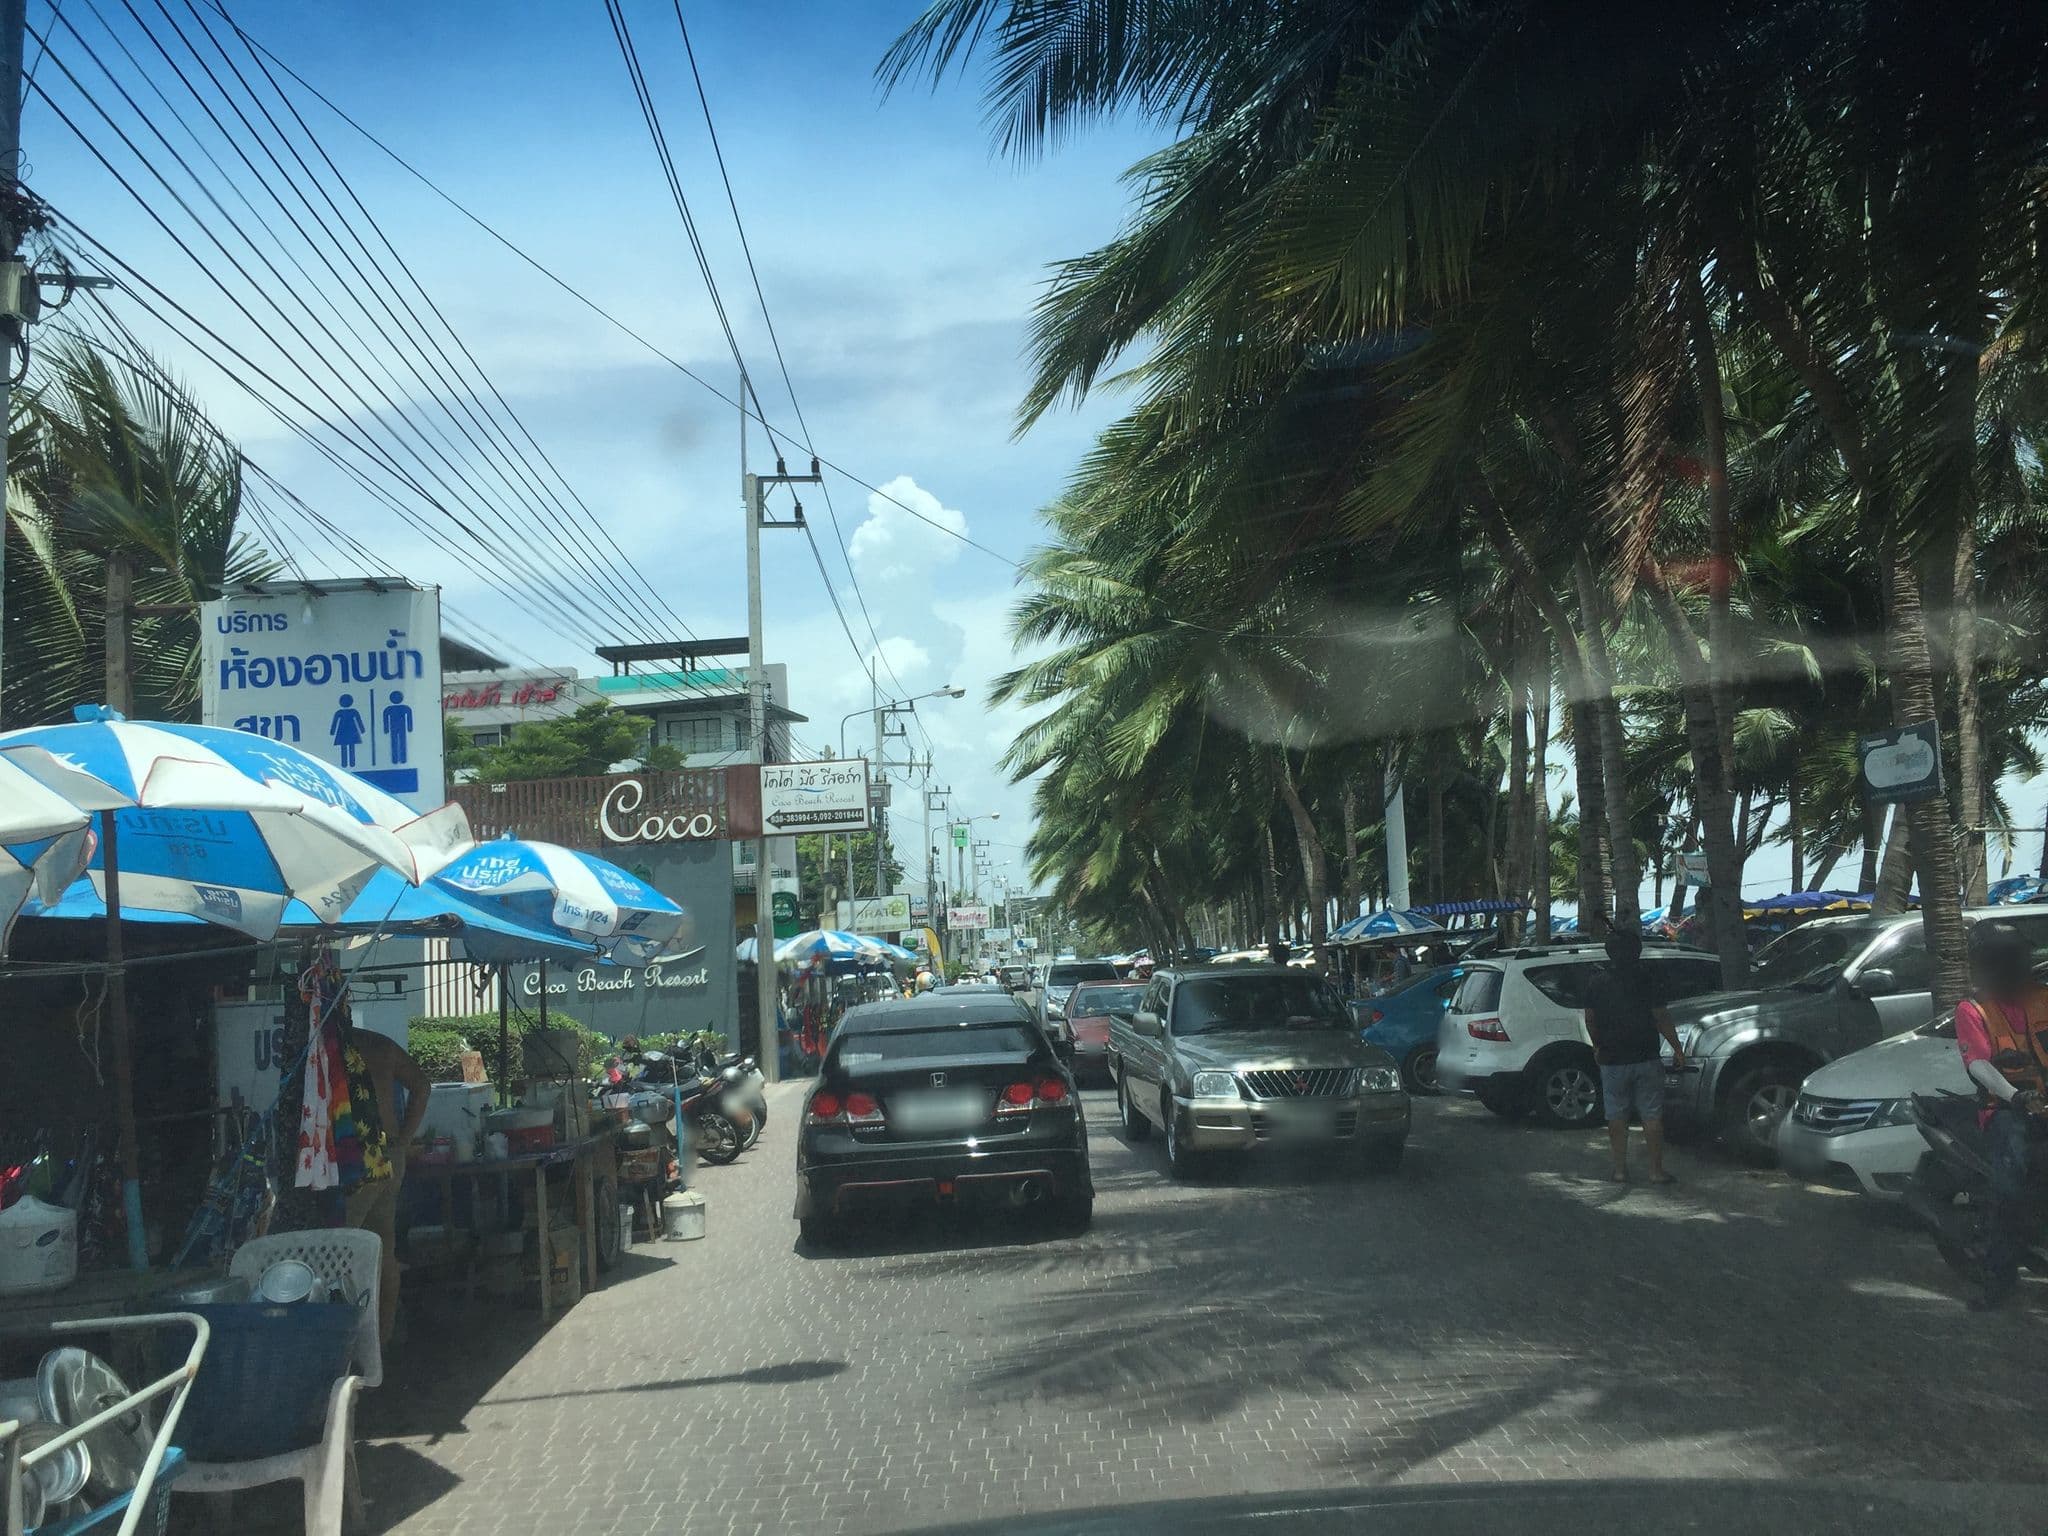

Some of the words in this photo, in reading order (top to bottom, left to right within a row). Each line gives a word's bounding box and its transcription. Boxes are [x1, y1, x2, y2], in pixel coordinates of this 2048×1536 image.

[217, 610, 289, 635] บริการ
[220, 629, 425, 690] ห้องอาบน้ำ
[600, 779, 717, 842] Coco
[577, 968, 635, 992] Beach
[644, 964, 709, 988] Resort
